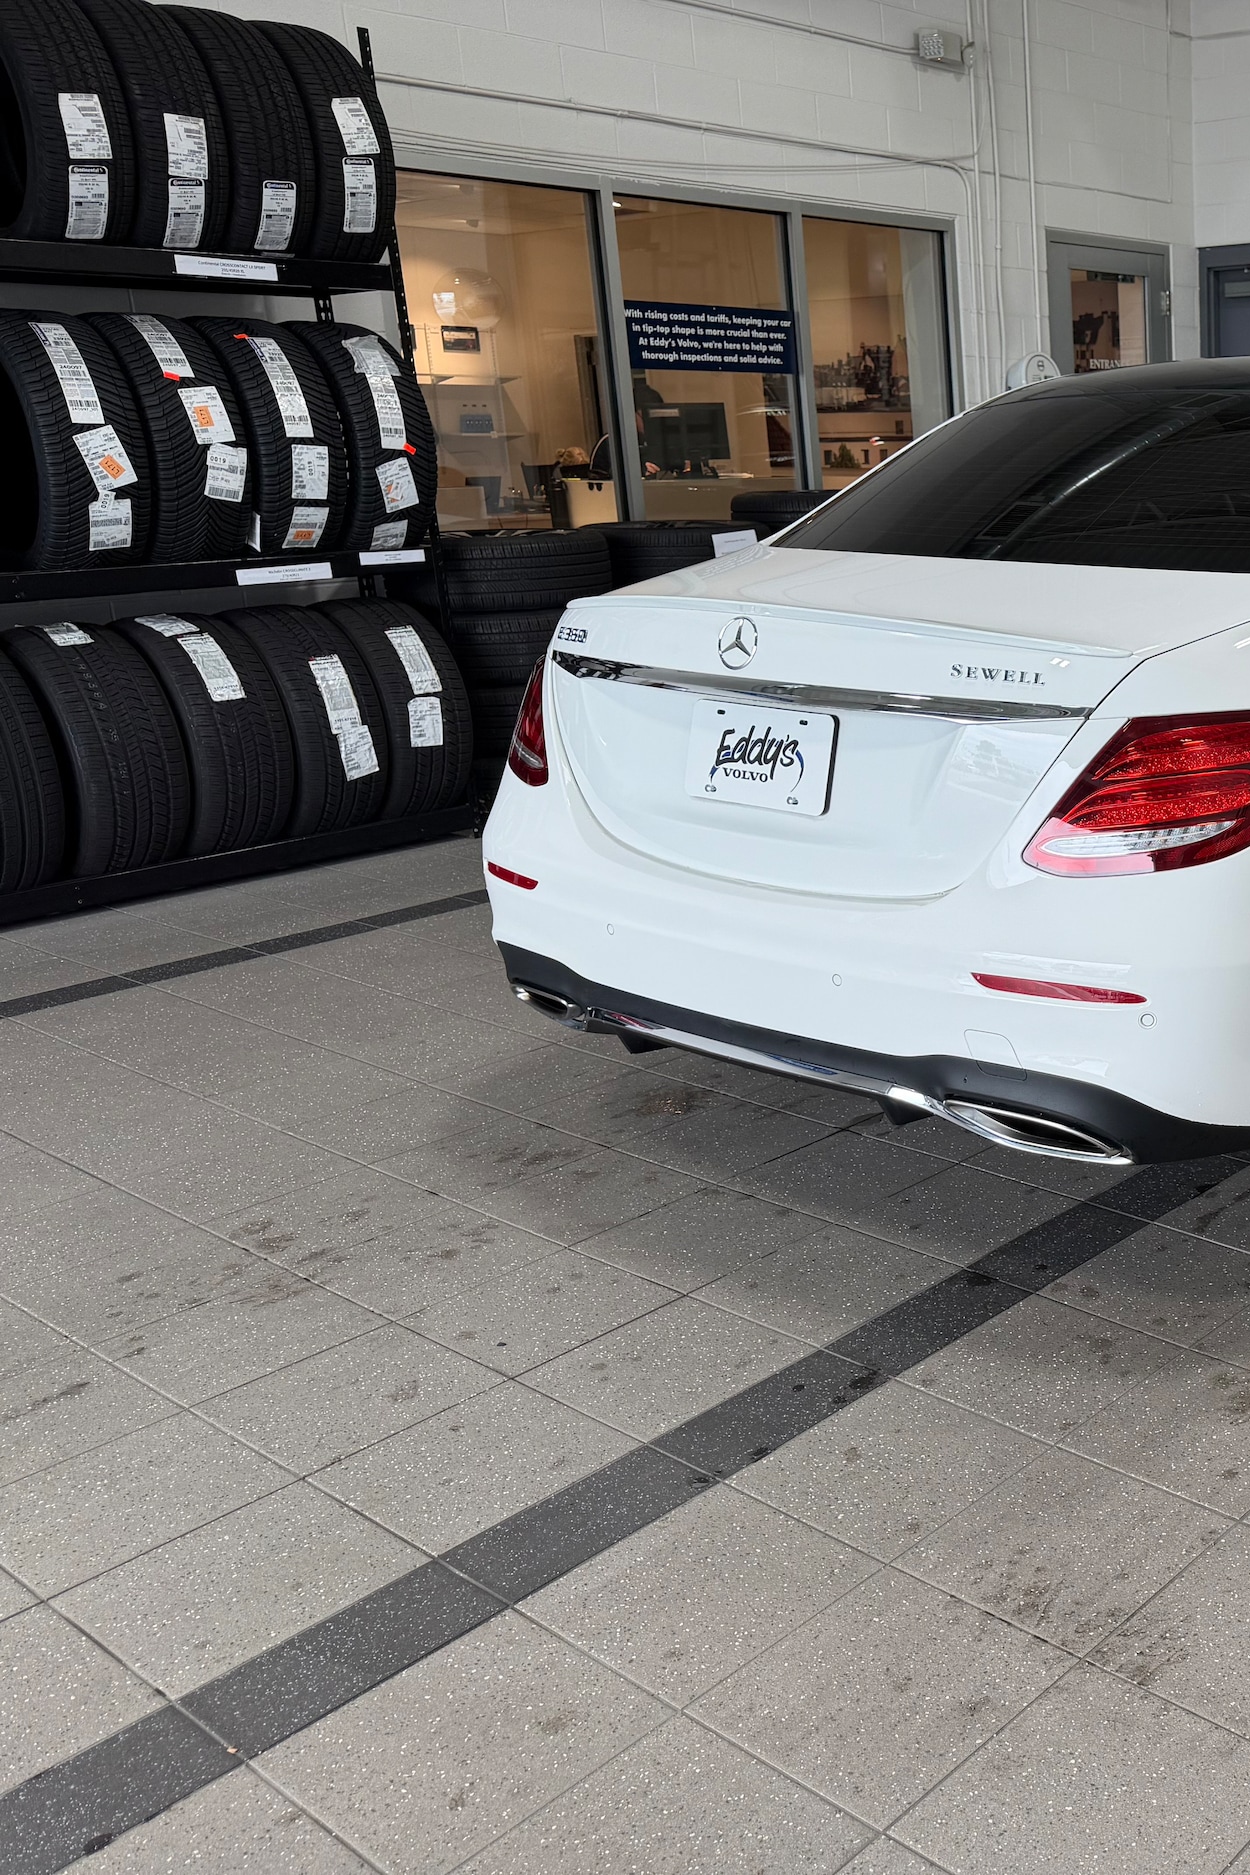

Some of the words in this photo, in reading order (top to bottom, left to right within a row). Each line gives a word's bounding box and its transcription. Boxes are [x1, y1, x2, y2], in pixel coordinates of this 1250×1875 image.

[624, 309, 643, 318] With
[645, 310, 668, 321] rising
[669, 313, 689, 321] costs
[690, 313, 705, 322] and
[707, 313, 731, 324] tariffs,
[732, 315, 762, 327] keeping
[763, 319, 779, 327] your
[632, 322, 640, 331] in
[642, 323, 670, 335] tip-top
[672, 325, 696, 336] shape
[697, 326, 704, 335] is
[705, 328, 725, 336] more
[726, 328, 750, 337] crucial
[751, 329, 768, 338] than
[638, 337, 648, 345] At
[649, 337, 676, 348] Eddy's
[677, 338, 701, 349] Volvo,
[702, 340, 722, 349] we're
[723, 340, 741, 350] here
[742, 342, 750, 350] to
[751, 342, 767, 353] help
[768, 343, 784, 352] with
[642, 350, 679, 362] thorough
[680, 352, 722, 363] inspections
[723, 354, 738, 363] and
[740, 354, 757, 363] solid
[758, 355, 783, 365] advice.
[1089, 358, 1124, 370] ENTRAN
[950, 663, 1046, 687] SEWELL
[715, 725, 799, 780] Eddy's
[722, 767, 768, 783] VOLVO
